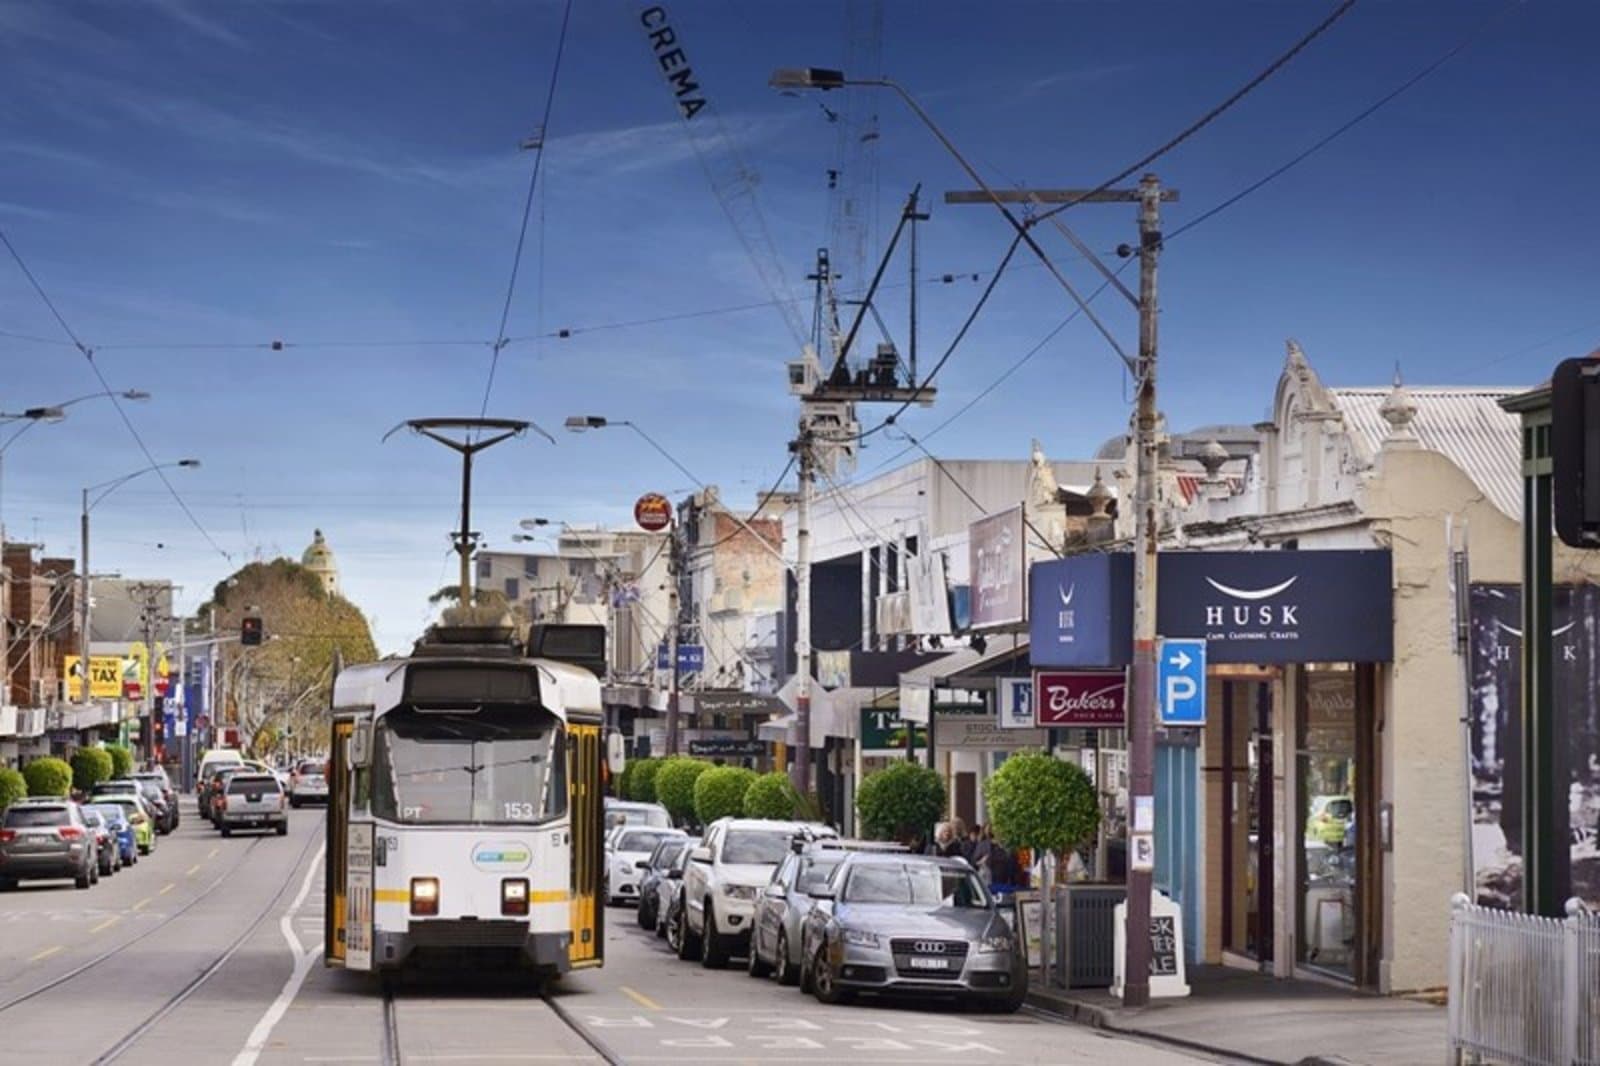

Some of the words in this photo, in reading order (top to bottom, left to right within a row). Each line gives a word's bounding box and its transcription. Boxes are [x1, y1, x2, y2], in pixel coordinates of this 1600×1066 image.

[640, 5, 707, 120] CREMA
[1205, 605, 1299, 626] HUSK
[91, 668, 117, 682] TAX
[1046, 684, 1116, 721] Bakers
[1166, 675, 1196, 714] P
[503, 802, 533, 819] 153
